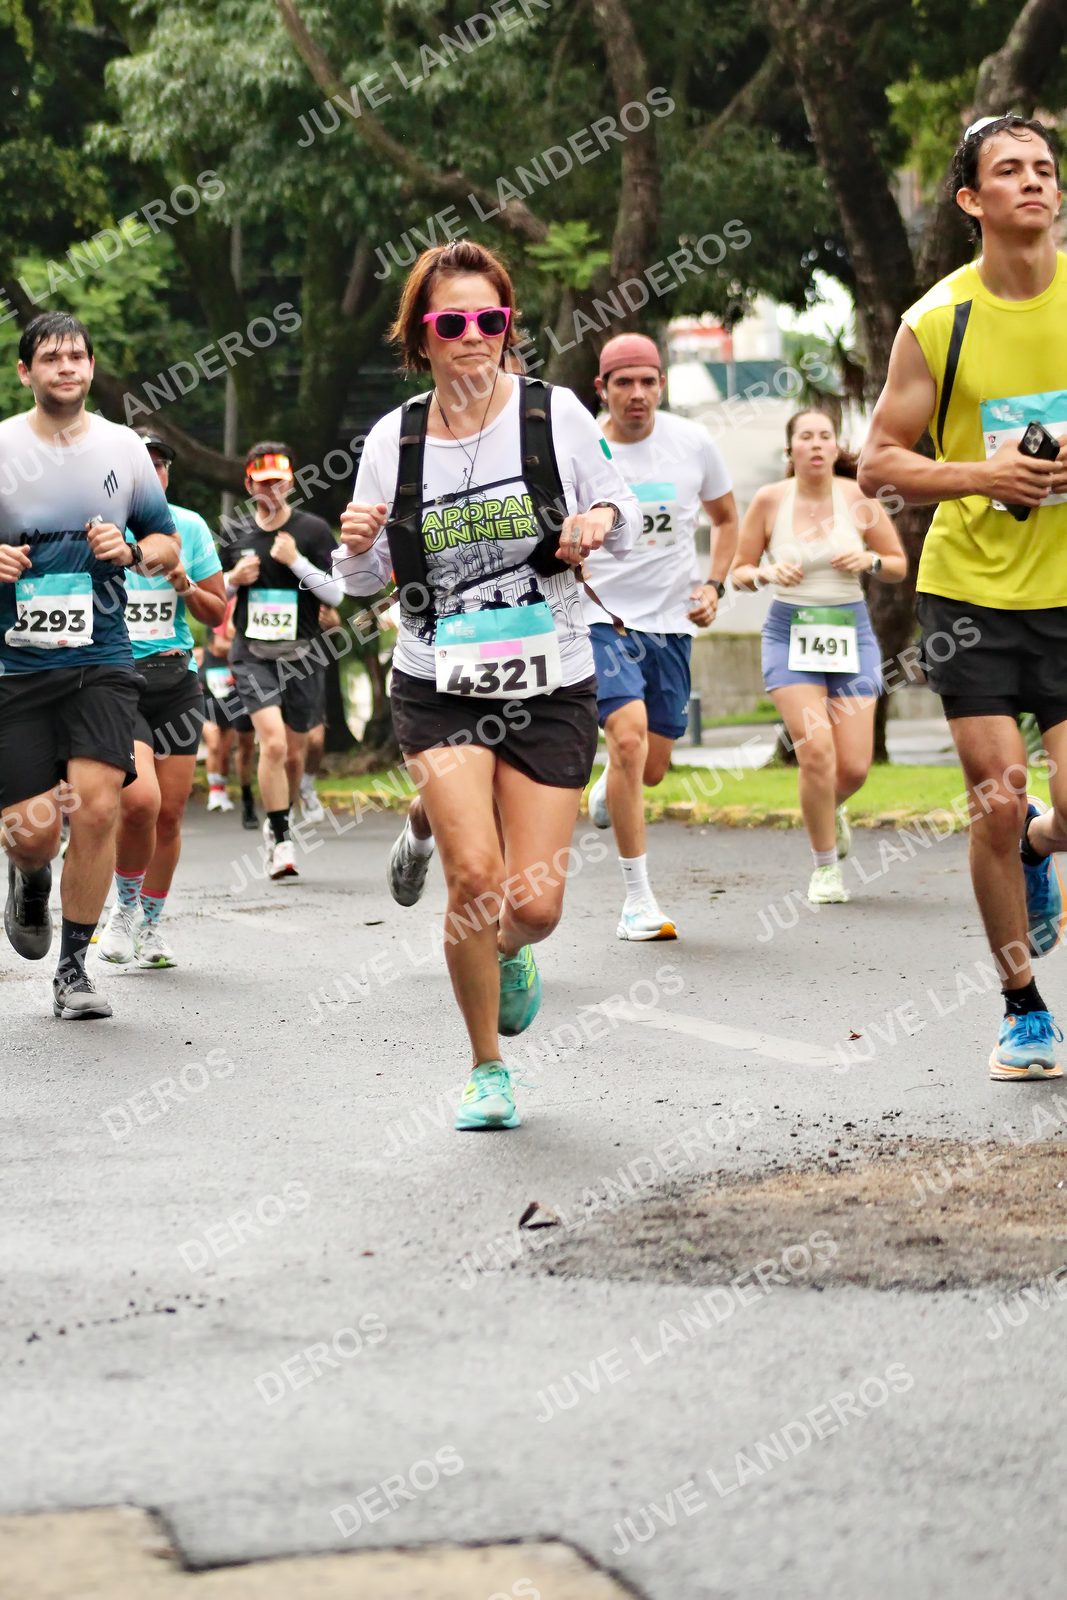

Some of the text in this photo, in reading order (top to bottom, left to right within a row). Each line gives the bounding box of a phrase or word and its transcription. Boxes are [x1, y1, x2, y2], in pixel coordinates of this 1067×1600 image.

[423, 517, 538, 553] UNNER
[124, 602, 173, 622] 335
[252, 612, 292, 627] 4632
[798, 636, 848, 657] 1491
[447, 654, 548, 695] 4321
